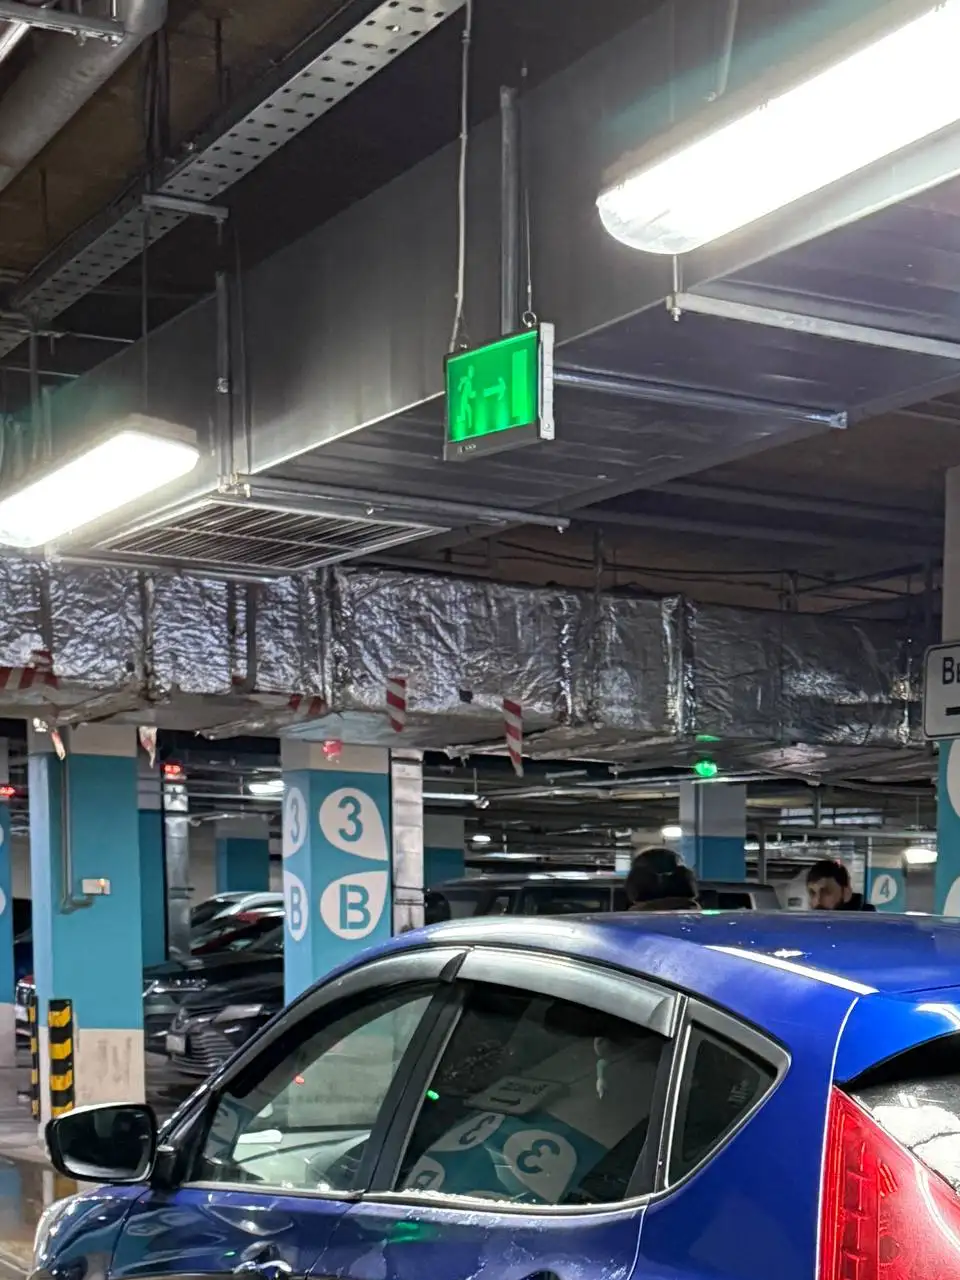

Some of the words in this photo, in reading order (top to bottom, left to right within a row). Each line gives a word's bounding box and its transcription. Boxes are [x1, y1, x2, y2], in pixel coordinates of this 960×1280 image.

[290, 796, 300, 844] 3
[338, 795, 363, 842] 3
[290, 886, 303, 931] B
[339, 884, 371, 930] B
[879, 877, 890, 898] 4
